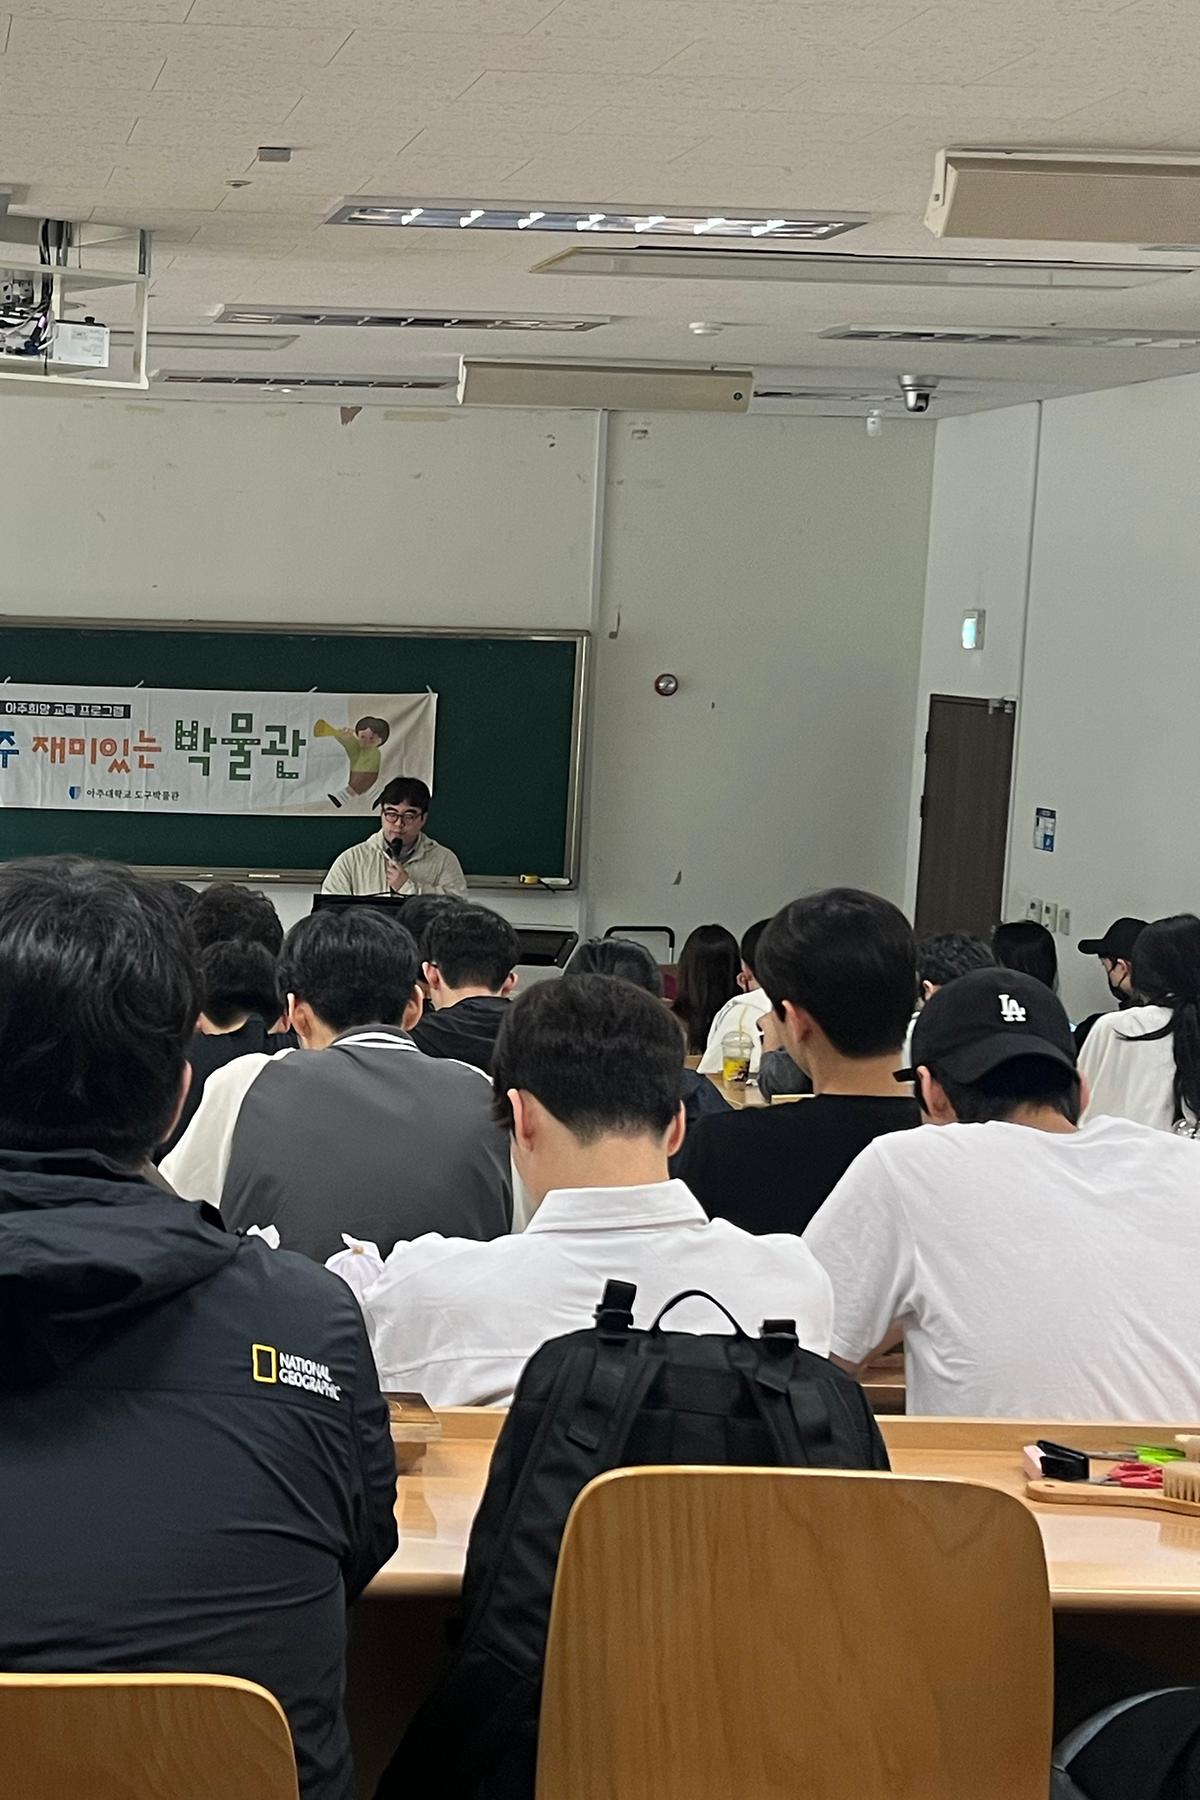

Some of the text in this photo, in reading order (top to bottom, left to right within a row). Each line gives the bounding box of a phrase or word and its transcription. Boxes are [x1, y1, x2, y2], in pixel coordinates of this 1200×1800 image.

[5, 702, 125, 718] 아주희망 교육 프로그램
[31, 729, 162, 774] 재미있는
[175, 713, 307, 781] 박물관
[86, 788, 180, 802] 아주대학교 도구박물관
[998, 994, 1026, 1022] LA
[279, 1351, 332, 1382] NATIONAL
[278, 1368, 341, 1401] GEOGRAPHIC
